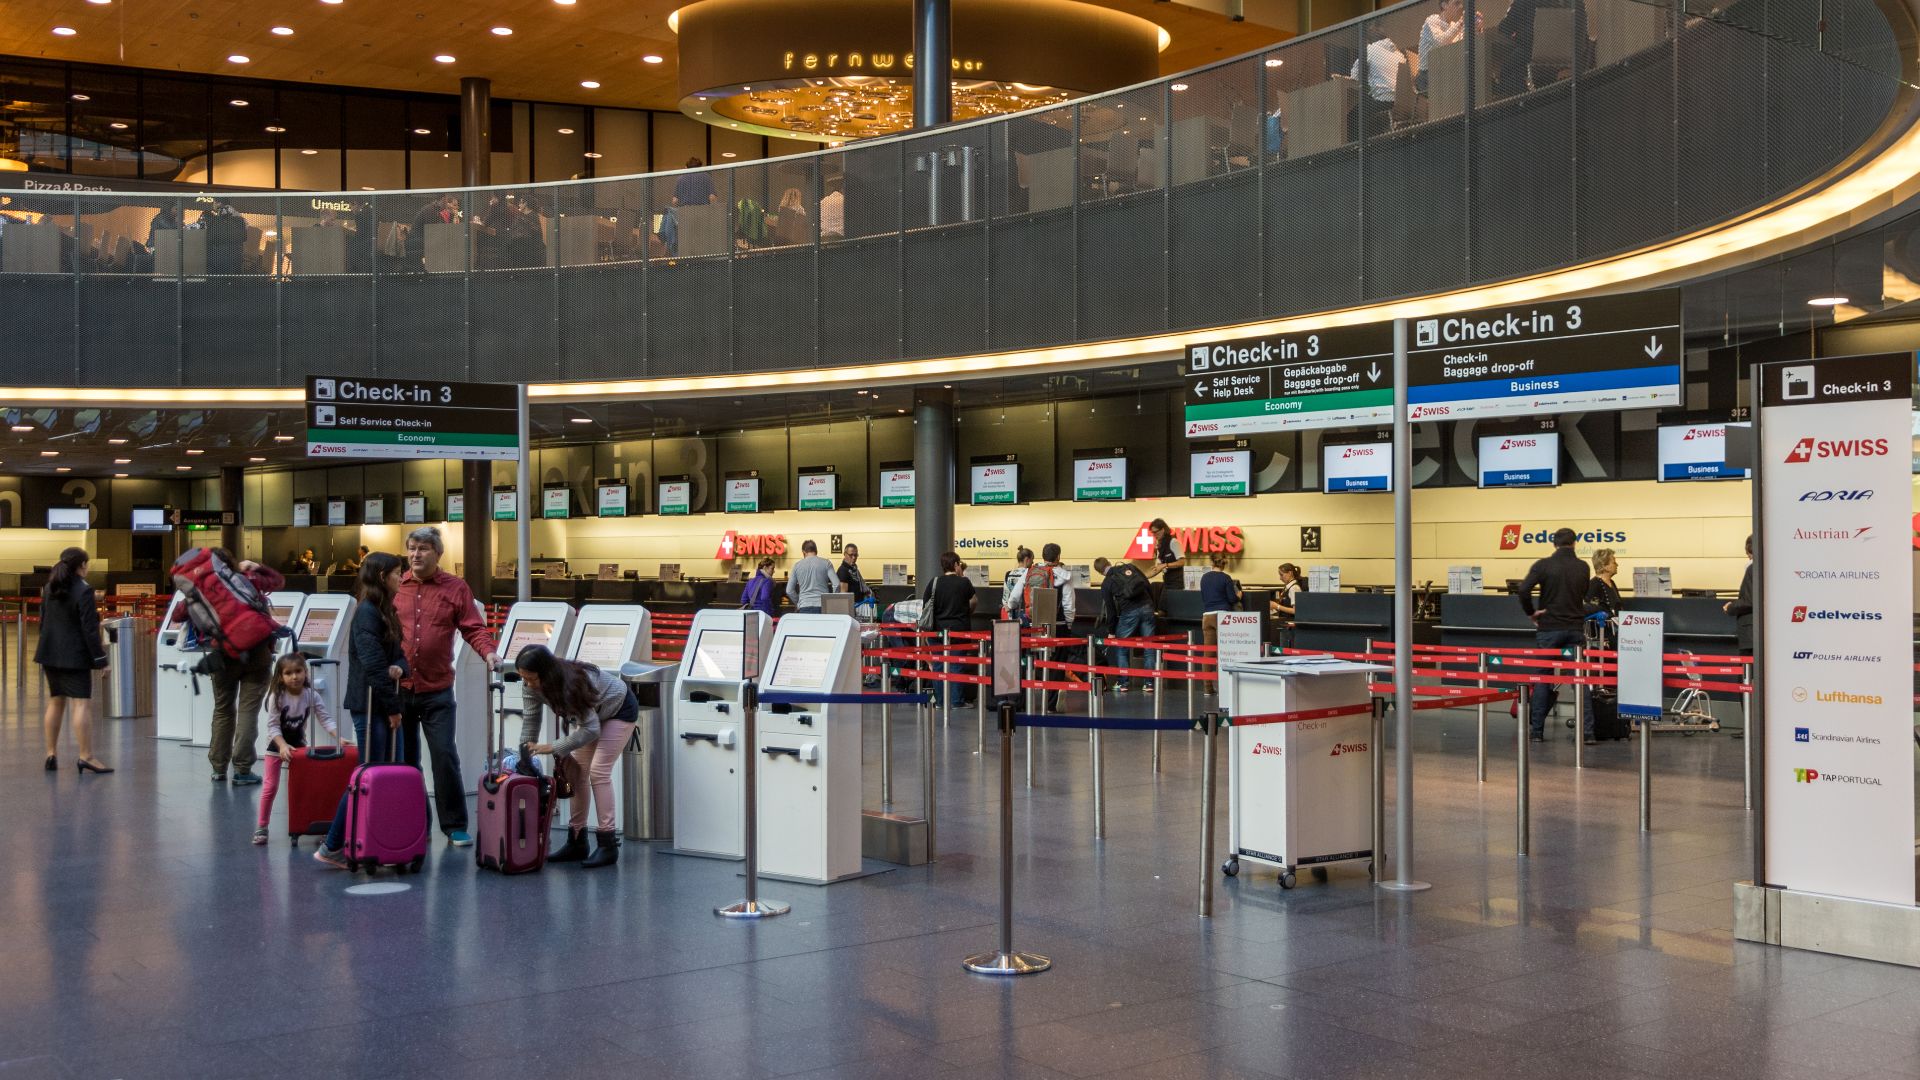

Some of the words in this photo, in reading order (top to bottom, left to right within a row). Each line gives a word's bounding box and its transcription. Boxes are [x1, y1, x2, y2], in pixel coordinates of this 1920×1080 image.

[785, 51, 914, 70] fernwe
[951, 58, 985, 71] bar
[1443, 310, 1555, 342] Check-in
[1566, 305, 1583, 330] 3
[1212, 340, 1299, 367] Check-in
[1308, 334, 1321, 357] 3
[1443, 352, 1489, 366] Check-in
[1284, 362, 1348, 379] Gepäckabgabe
[1443, 364, 1488, 379] Baggage
[1491, 359, 1535, 375] drop-off
[1213, 377, 1230, 388] Self
[1232, 374, 1261, 386] Service
[1284, 376, 1322, 391] Baggage
[1324, 372, 1360, 387] drop-off
[1510, 379, 1560, 393] Business
[340, 381, 432, 403] Check-in
[441, 386, 453, 404] 3
[1213, 388, 1231, 400] Help
[1234, 386, 1254, 397] Desk
[1823, 380, 1880, 397] Check-in
[1883, 378, 1893, 391] 3
[1265, 401, 1303, 413] Economy
[1423, 405, 1450, 416] SWISS
[1731, 408, 1747, 418] 312
[340, 416, 358, 426] Self
[360, 417, 392, 427] Service
[395, 418, 432, 429] Check-in
[1198, 423, 1219, 433] SWISS
[1541, 420, 1555, 429] 313
[398, 433, 436, 444] Economy
[1377, 432, 1389, 440] 314
[1696, 429, 1726, 439] SWISS
[1237, 440, 1248, 448] 315
[1511, 439, 1537, 448] SWISS
[1817, 438, 1888, 459] SWISS
[322, 446, 347, 454] SWISS
[1352, 448, 1374, 458] SWISS
[1216, 456, 1234, 465] SWISS
[990, 468, 1005, 476] SWISS
[1095, 463, 1112, 471] SWISS
[1688, 466, 1719, 474] Business
[1345, 478, 1369, 487] Business
[1504, 473, 1531, 481] Business
[1799, 490, 1874, 502] ADRIA
[1170, 525, 1243, 553] WISS
[1523, 529, 1627, 544] edeeiss
[1793, 527, 1849, 541] Austrian
[737, 533, 785, 557] SWISS
[1799, 570, 1836, 581] CROATIA
[1839, 570, 1880, 581] AIRLINES
[1231, 616, 1258, 625] SWISS
[1634, 616, 1661, 626] SWISS
[1808, 609, 1883, 622] edelweiss
[1620, 637, 1643, 646] Check-in
[1620, 645, 1642, 653] Business
[1793, 652, 1812, 661] LOT
[1812, 652, 1843, 662] POLISH
[1844, 653, 1881, 664] AIRLINES
[1816, 689, 1882, 705] Lufthansa
[1297, 721, 1327, 731] Check-in
[1812, 731, 1855, 744] Scandinavian
[1856, 734, 1881, 746] Airlines
[1342, 743, 1368, 755] SWISS
[1794, 767, 1819, 784] TAP
[1821, 773, 1836, 784] TAP
[1837, 773, 1883, 787] PORTUGAL
